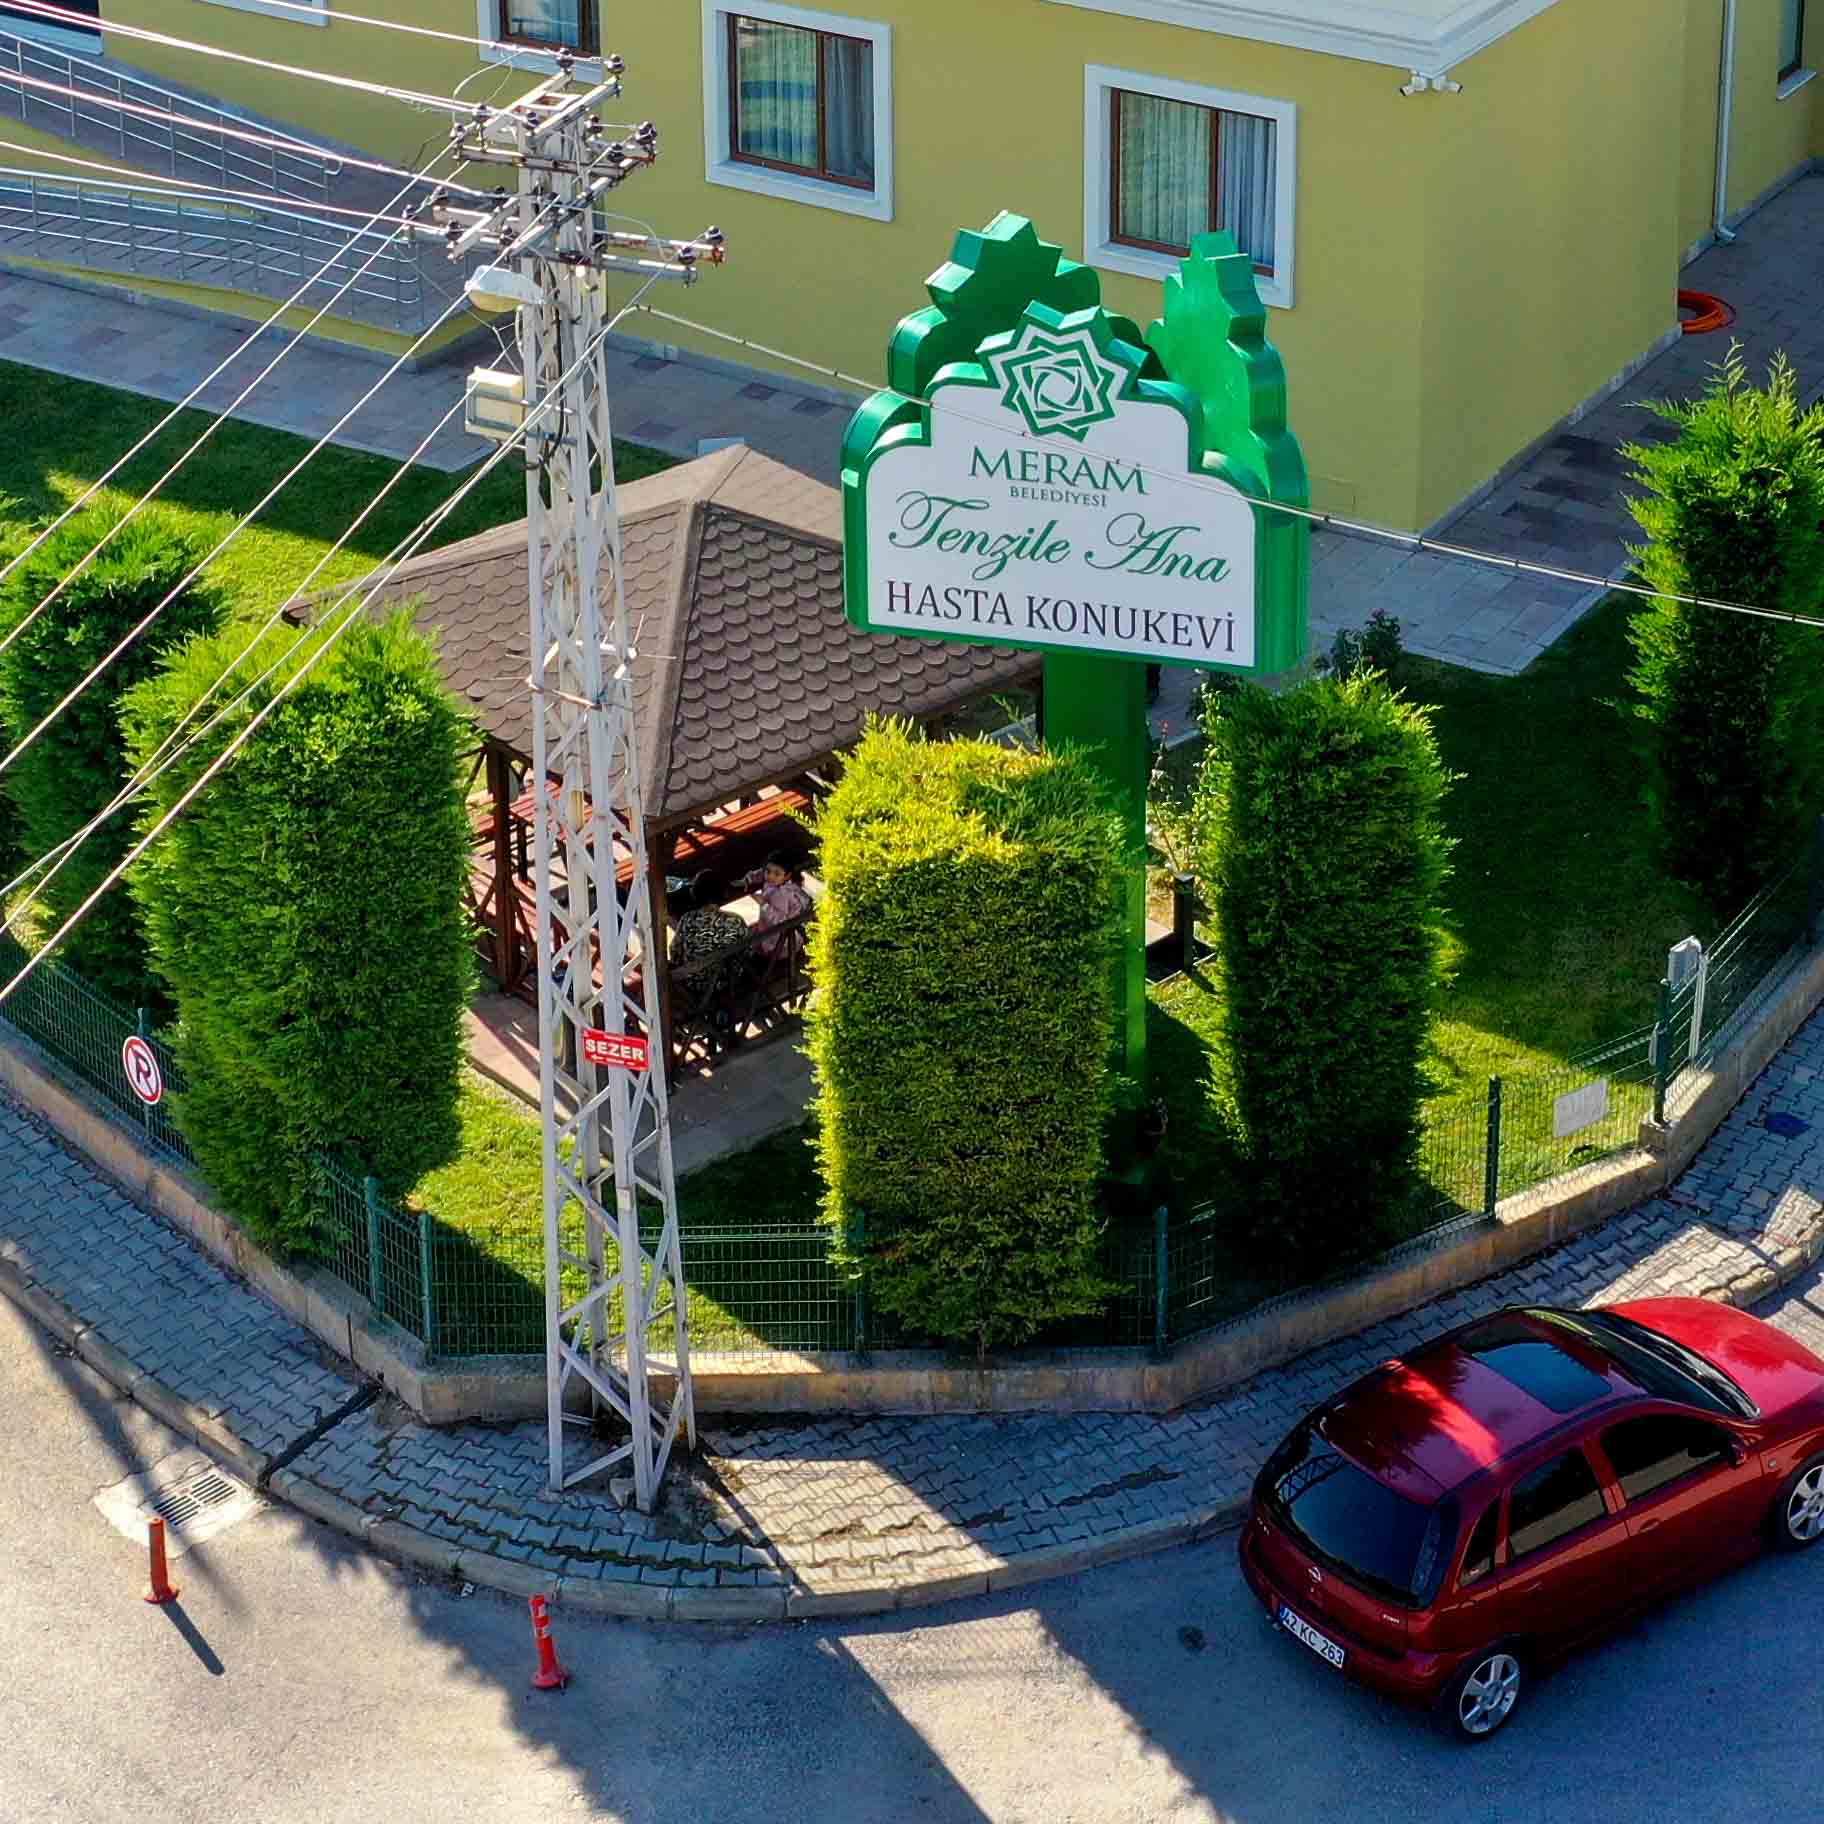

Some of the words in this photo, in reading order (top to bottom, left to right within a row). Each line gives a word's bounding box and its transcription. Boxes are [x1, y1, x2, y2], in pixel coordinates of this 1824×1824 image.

[968, 446, 1152, 495] MERAM
[1009, 486, 1107, 508] BELEDİYESİ
[888, 490, 1072, 581] Tenzile
[1084, 512, 1232, 583] Ana
[886, 580, 1013, 626] HASTA
[1026, 596, 1236, 653] KONUKEVİ
[585, 1038, 644, 1061] SEZER
[1299, 1622, 1319, 1647] KC
[1320, 1639, 1344, 1666] 263
